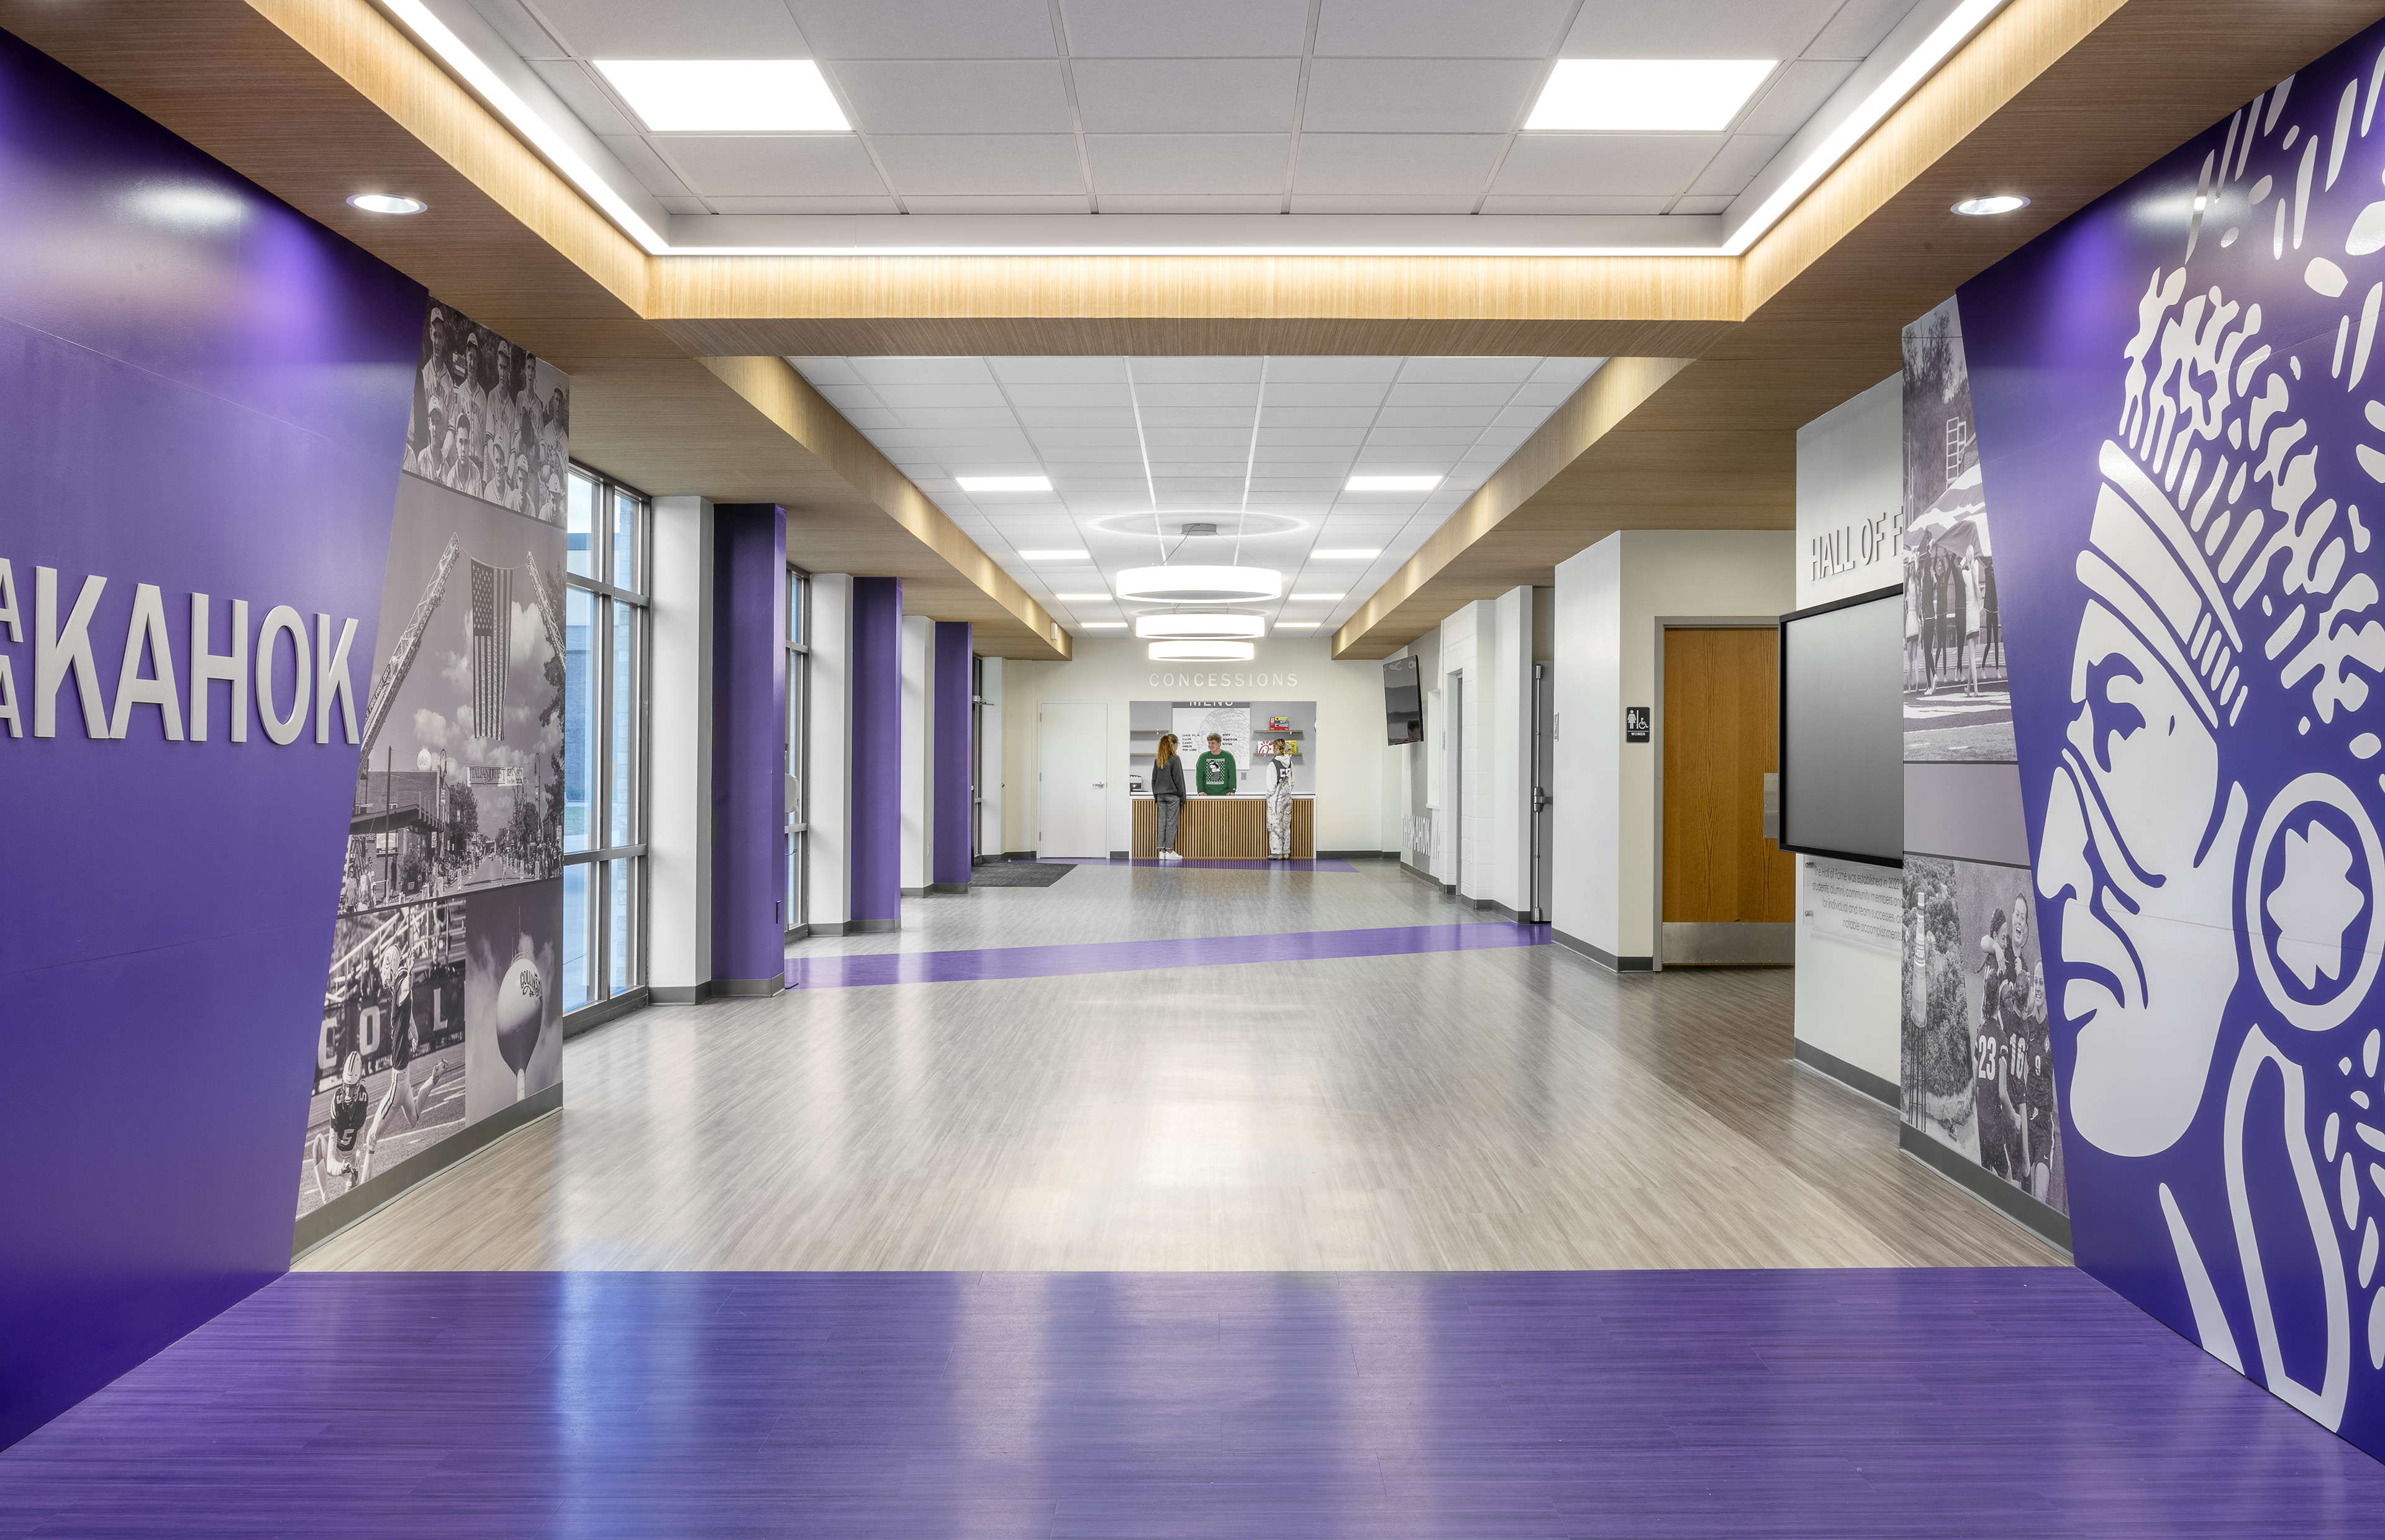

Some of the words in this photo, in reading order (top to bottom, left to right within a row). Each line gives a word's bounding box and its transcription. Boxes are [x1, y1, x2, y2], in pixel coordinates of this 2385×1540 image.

[1810, 527, 1855, 581] HALL
[1861, 512, 1886, 565] OF
[35, 566, 360, 745] KAHOK
[1149, 673, 1298, 687] CONCESSIONS
[1401, 813, 1411, 849] THE
[1411, 815, 1431, 857] KAHOK
[1830, 868, 1835, 879] of
[1835, 869, 1847, 881] Fame
[1848, 873, 1856, 882] was
[1857, 872, 1883, 887] established
[1883, 876, 1888, 888] in
[1889, 877, 1899, 889] 2022
[1828, 899, 1848, 912] individual
[1849, 904, 1858, 914] and
[1858, 907, 1871, 917] team
[1846, 890, 1870, 903] community
[1871, 892, 1892, 905] members
[1843, 918, 1860, 931] notable
[1978, 1035, 1996, 1080] 23
[2010, 1033, 2026, 1079] 16
[2035, 1055, 2041, 1076] 9
[341, 1128, 355, 1146] 5
